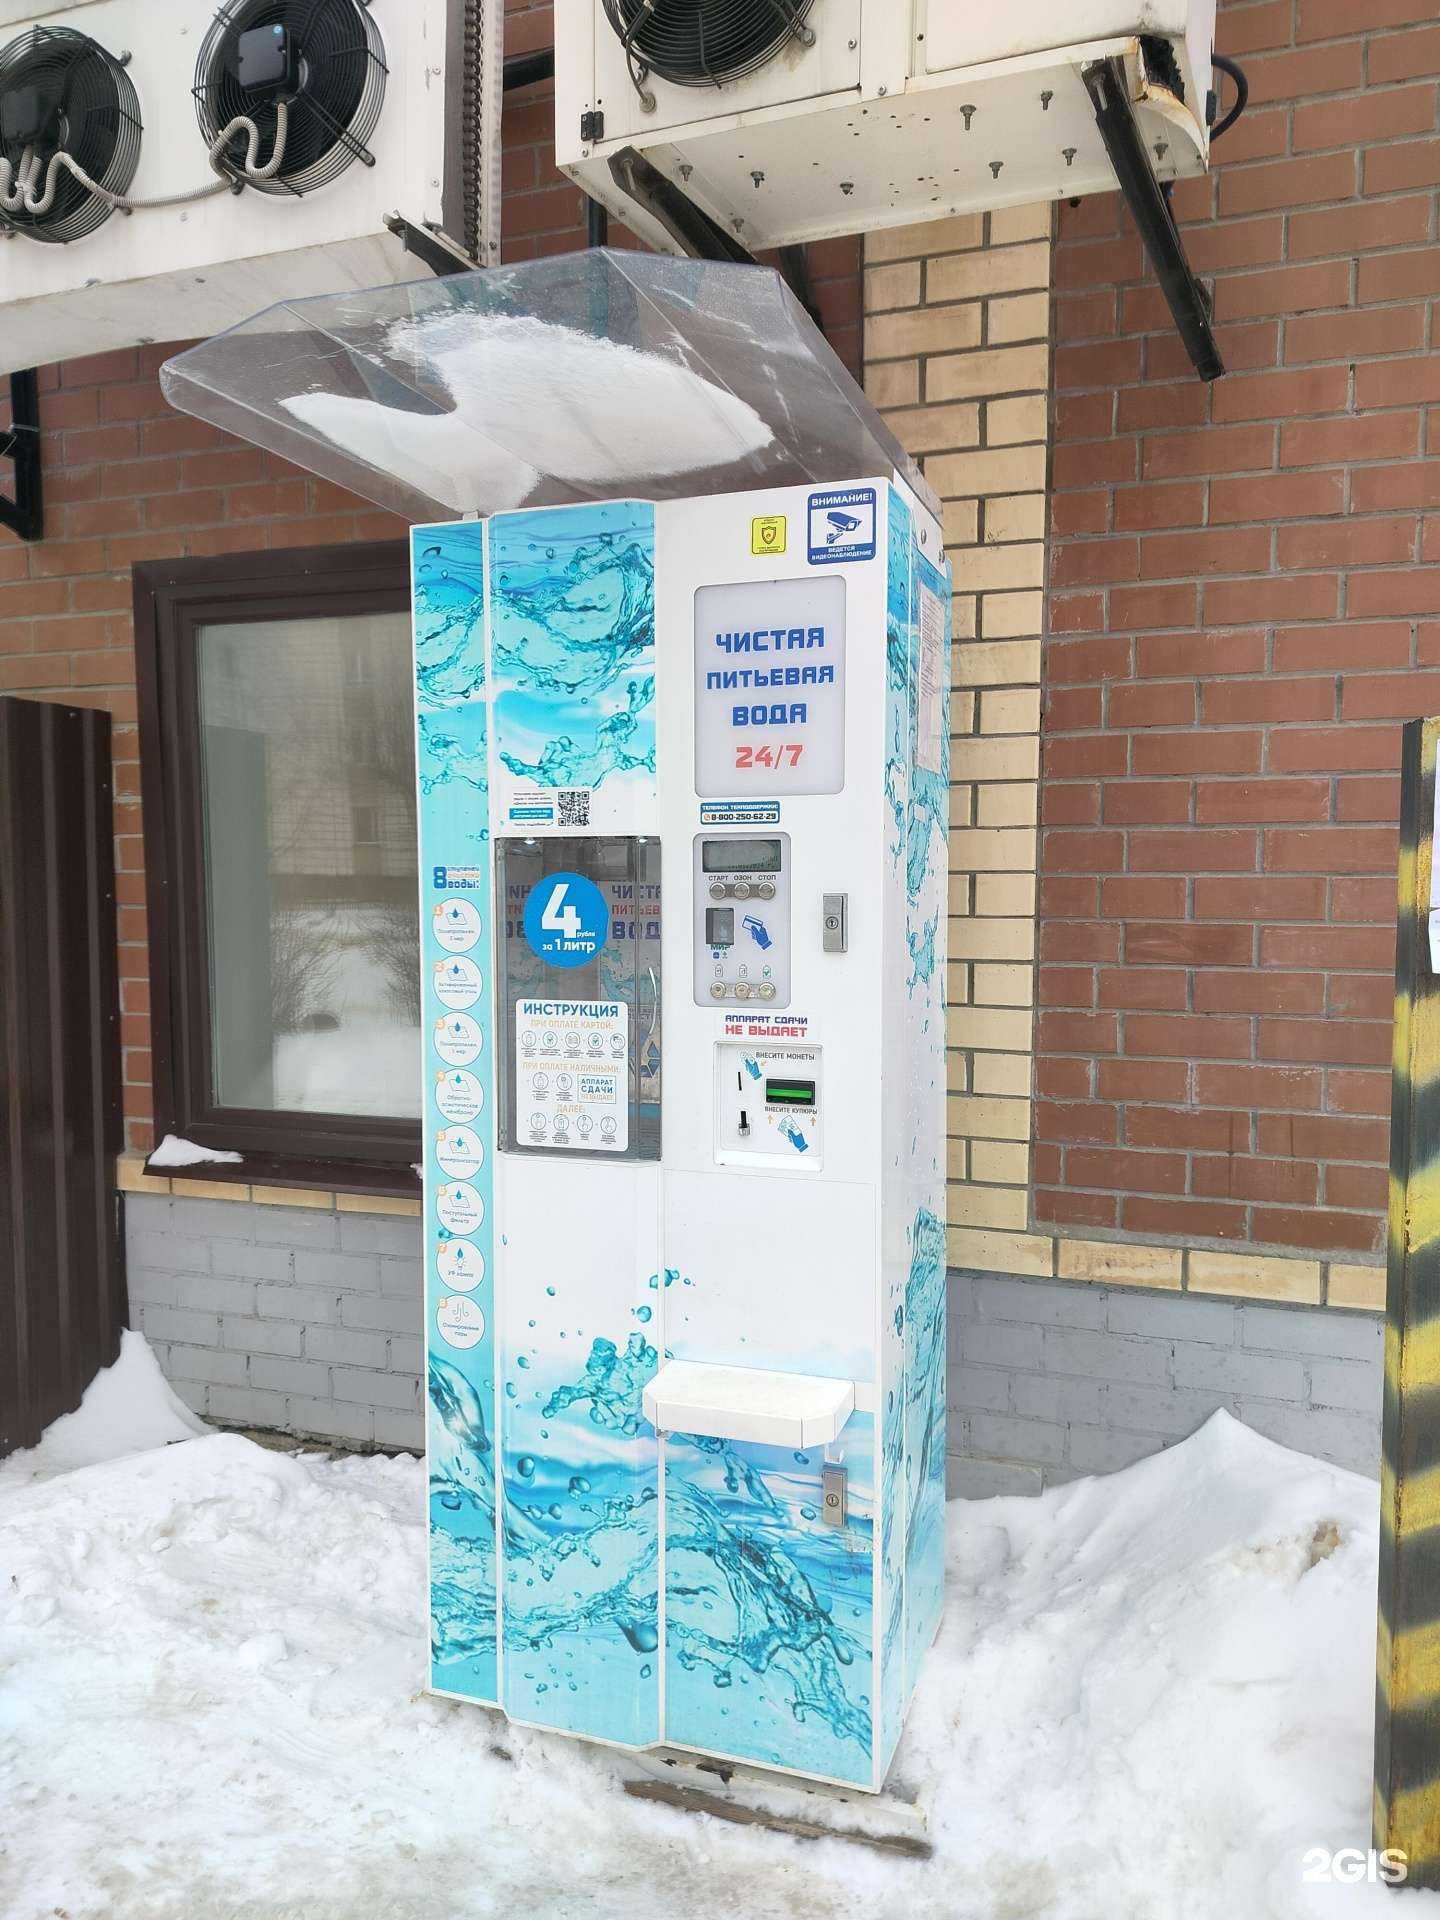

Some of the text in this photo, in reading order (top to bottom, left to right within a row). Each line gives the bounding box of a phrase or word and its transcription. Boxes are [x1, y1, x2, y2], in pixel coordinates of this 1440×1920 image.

[811, 492, 873, 507] ВНИМАНИЕ!
[811, 549, 872, 561] ВИДЕОНАБЛЮДЕНИЕ
[828, 545, 856, 553] ВЕДЕТСЯ
[716, 626, 825, 653] ЧИСТАЯ
[706, 664, 834, 690] ПИТЬЕВАЯ
[732, 703, 807, 727] ВОДА
[735, 744, 804, 770] 24/7
[711, 812, 776, 821] 8-800-250-62-29
[433, 866, 447, 889] 8
[758, 873, 776, 881] СТОП
[541, 883, 582, 939] 4
[542, 939, 596, 954] за 1 литр
[523, 1003, 619, 1019] ИНСТРУКЦИЯ
[548, 1019, 579, 1029] ОПЛАТЕ
[725, 1014, 808, 1025] АППАРАТ СДАЧИ
[725, 1024, 808, 1038] НЕ ВЫДАЕТ
[755, 1051, 815, 1061] ВНЕСИТЕ МОНЕТЫ
[539, 1062, 568, 1071] ОПЛАТЕ
[580, 1078, 614, 1086] АППАРАТ
[580, 1085, 614, 1094] СДАЧИ
[764, 1106, 818, 1115] ВНЕСИТЕ КУПЮРЫ
